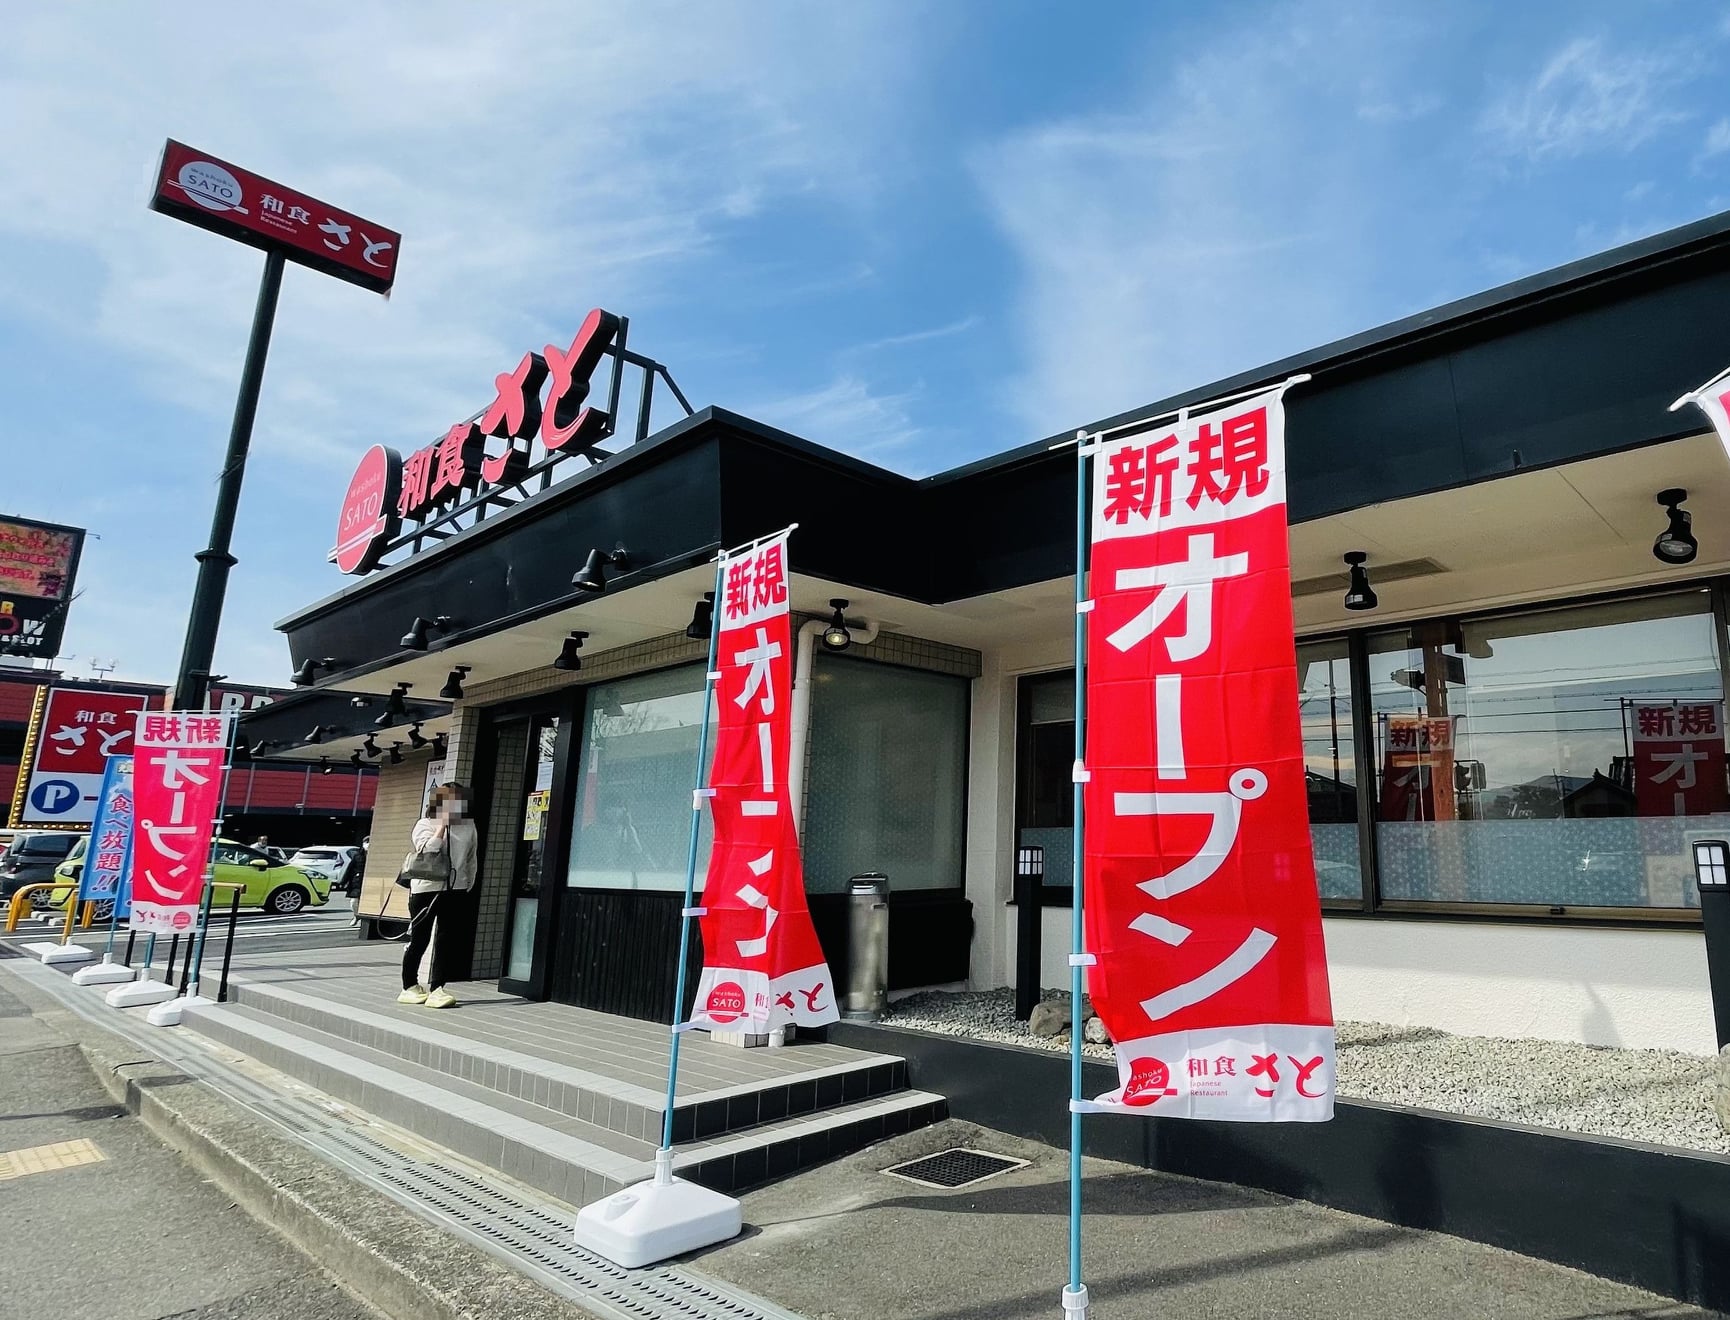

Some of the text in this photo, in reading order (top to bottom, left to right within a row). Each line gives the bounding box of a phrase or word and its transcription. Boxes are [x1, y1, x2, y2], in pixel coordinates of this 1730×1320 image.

[188, 174, 233, 199] SATO
[1104, 407, 1270, 523] 新規
[343, 492, 379, 532] SATO
[727, 542, 787, 621] 新規
[74, 709, 118, 725] 和食
[1638, 705, 1716, 737] 新規
[50, 724, 133, 757] さと
[1105, 533, 1279, 1023] オープン
[712, 997, 742, 1009] SATO
[1126, 1074, 1163, 1098] SATO
[1131, 1067, 1163, 1084] ashoku
[1189, 1080, 1222, 1089] Japanese
[1189, 1089, 1229, 1097] Restaurant
